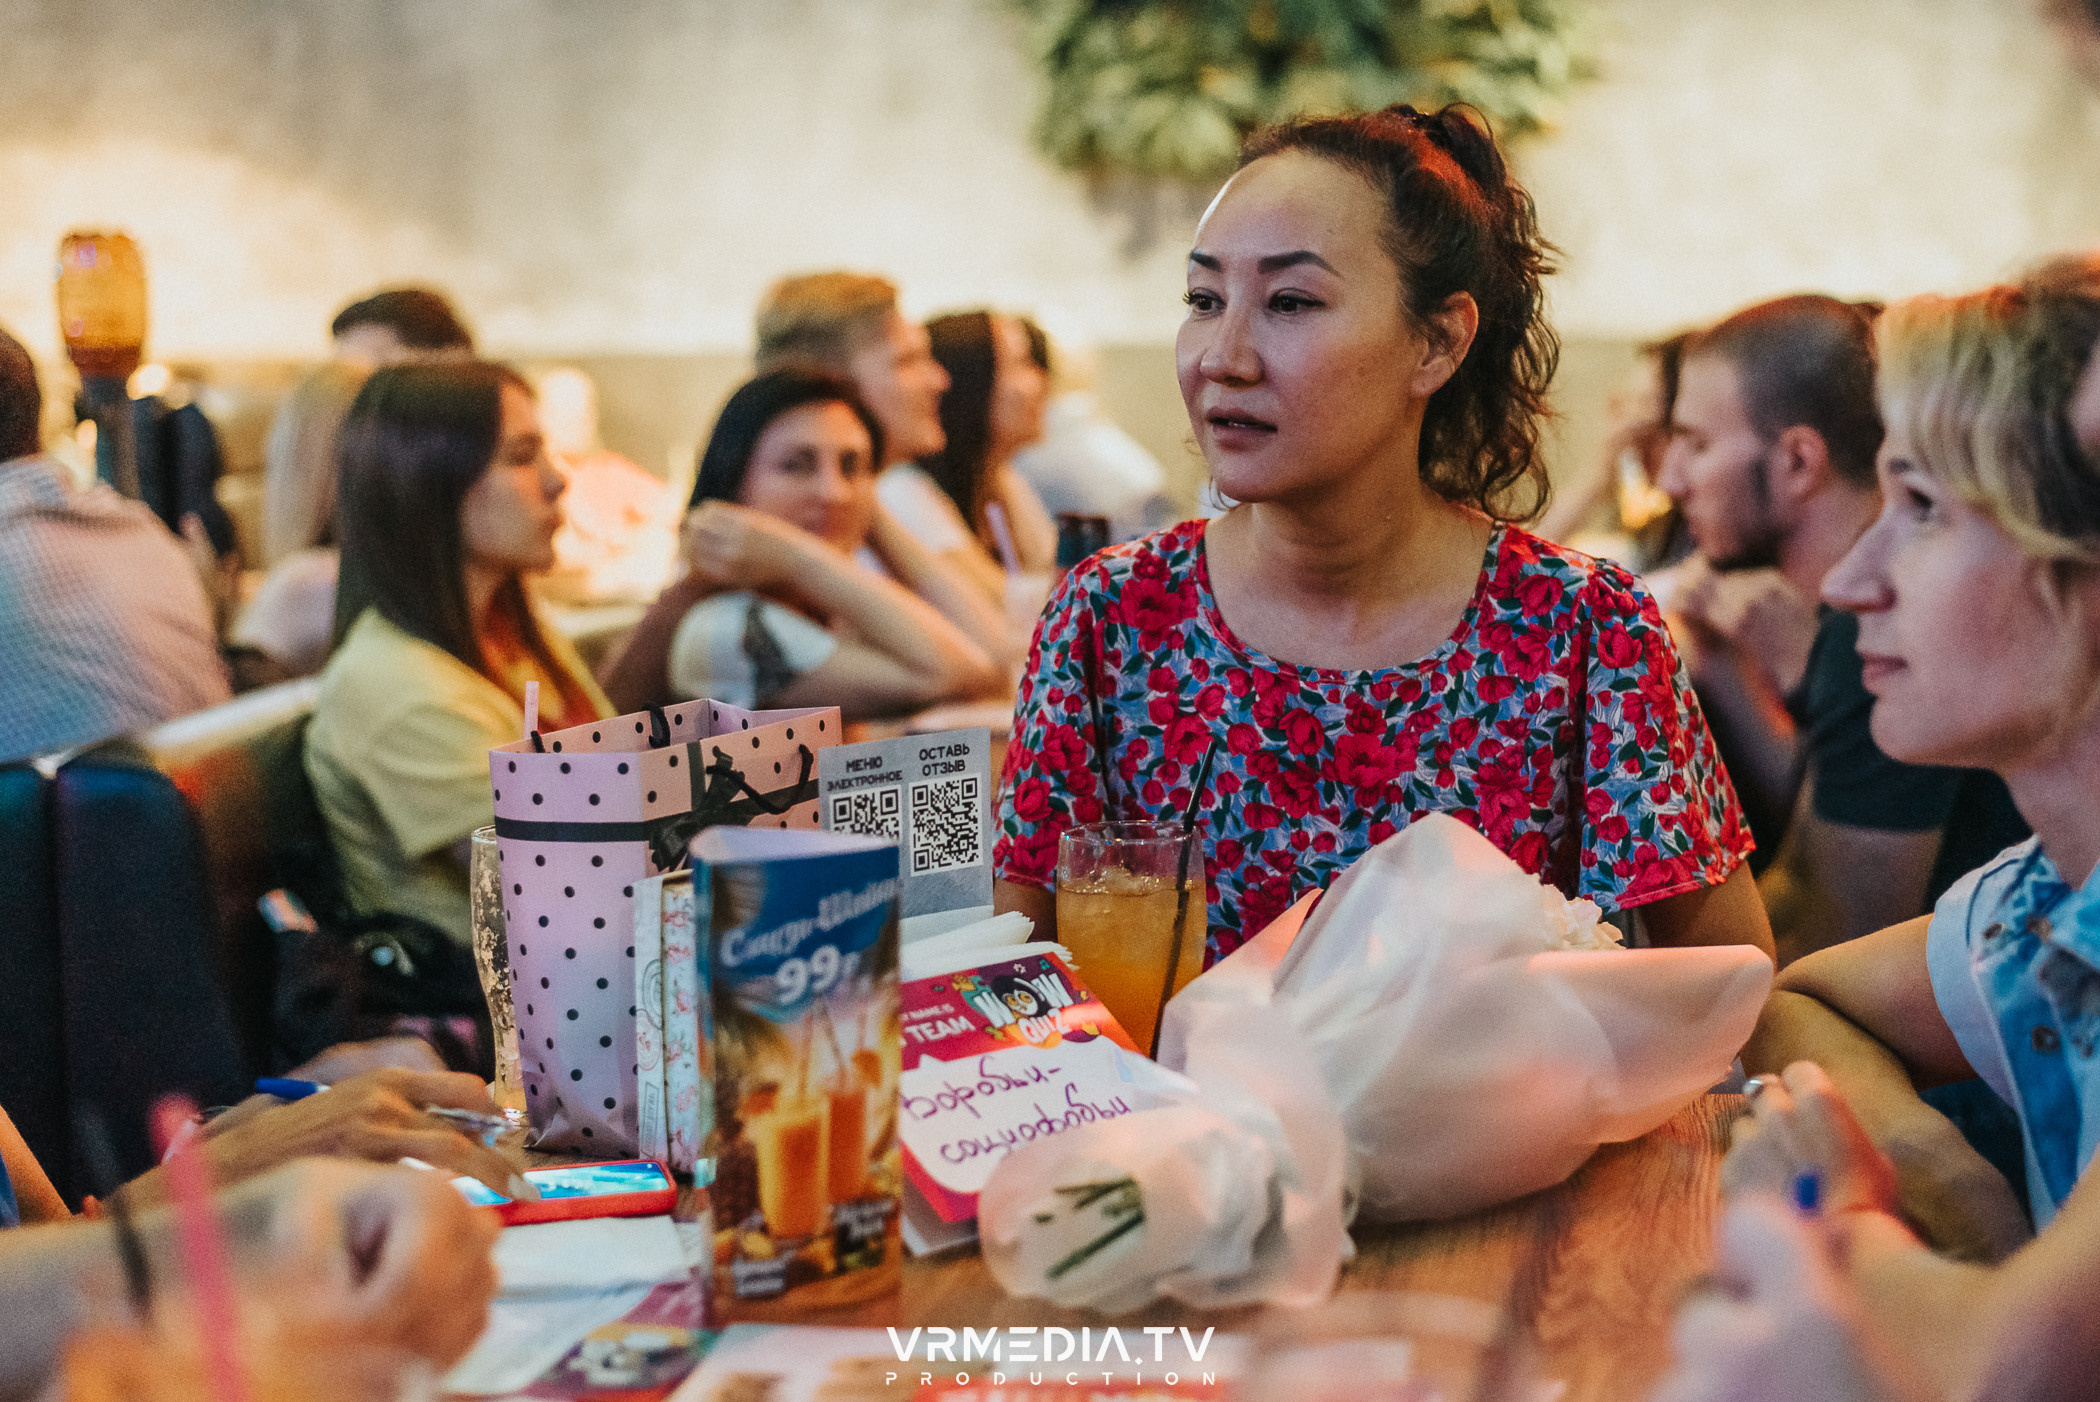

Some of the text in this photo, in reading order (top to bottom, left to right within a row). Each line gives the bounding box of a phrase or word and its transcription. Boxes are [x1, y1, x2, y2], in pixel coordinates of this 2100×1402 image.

[918, 743, 971, 762] ОСТАВЬ
[845, 755, 883, 774] МЕНЮ
[922, 759, 966, 777] ОТЗЫВ
[827, 769, 903, 792] ЭЛЕКТРОННОЕ
[904, 1015, 976, 1043] TEAM
[1018, 1007, 1073, 1043] QUIZ
